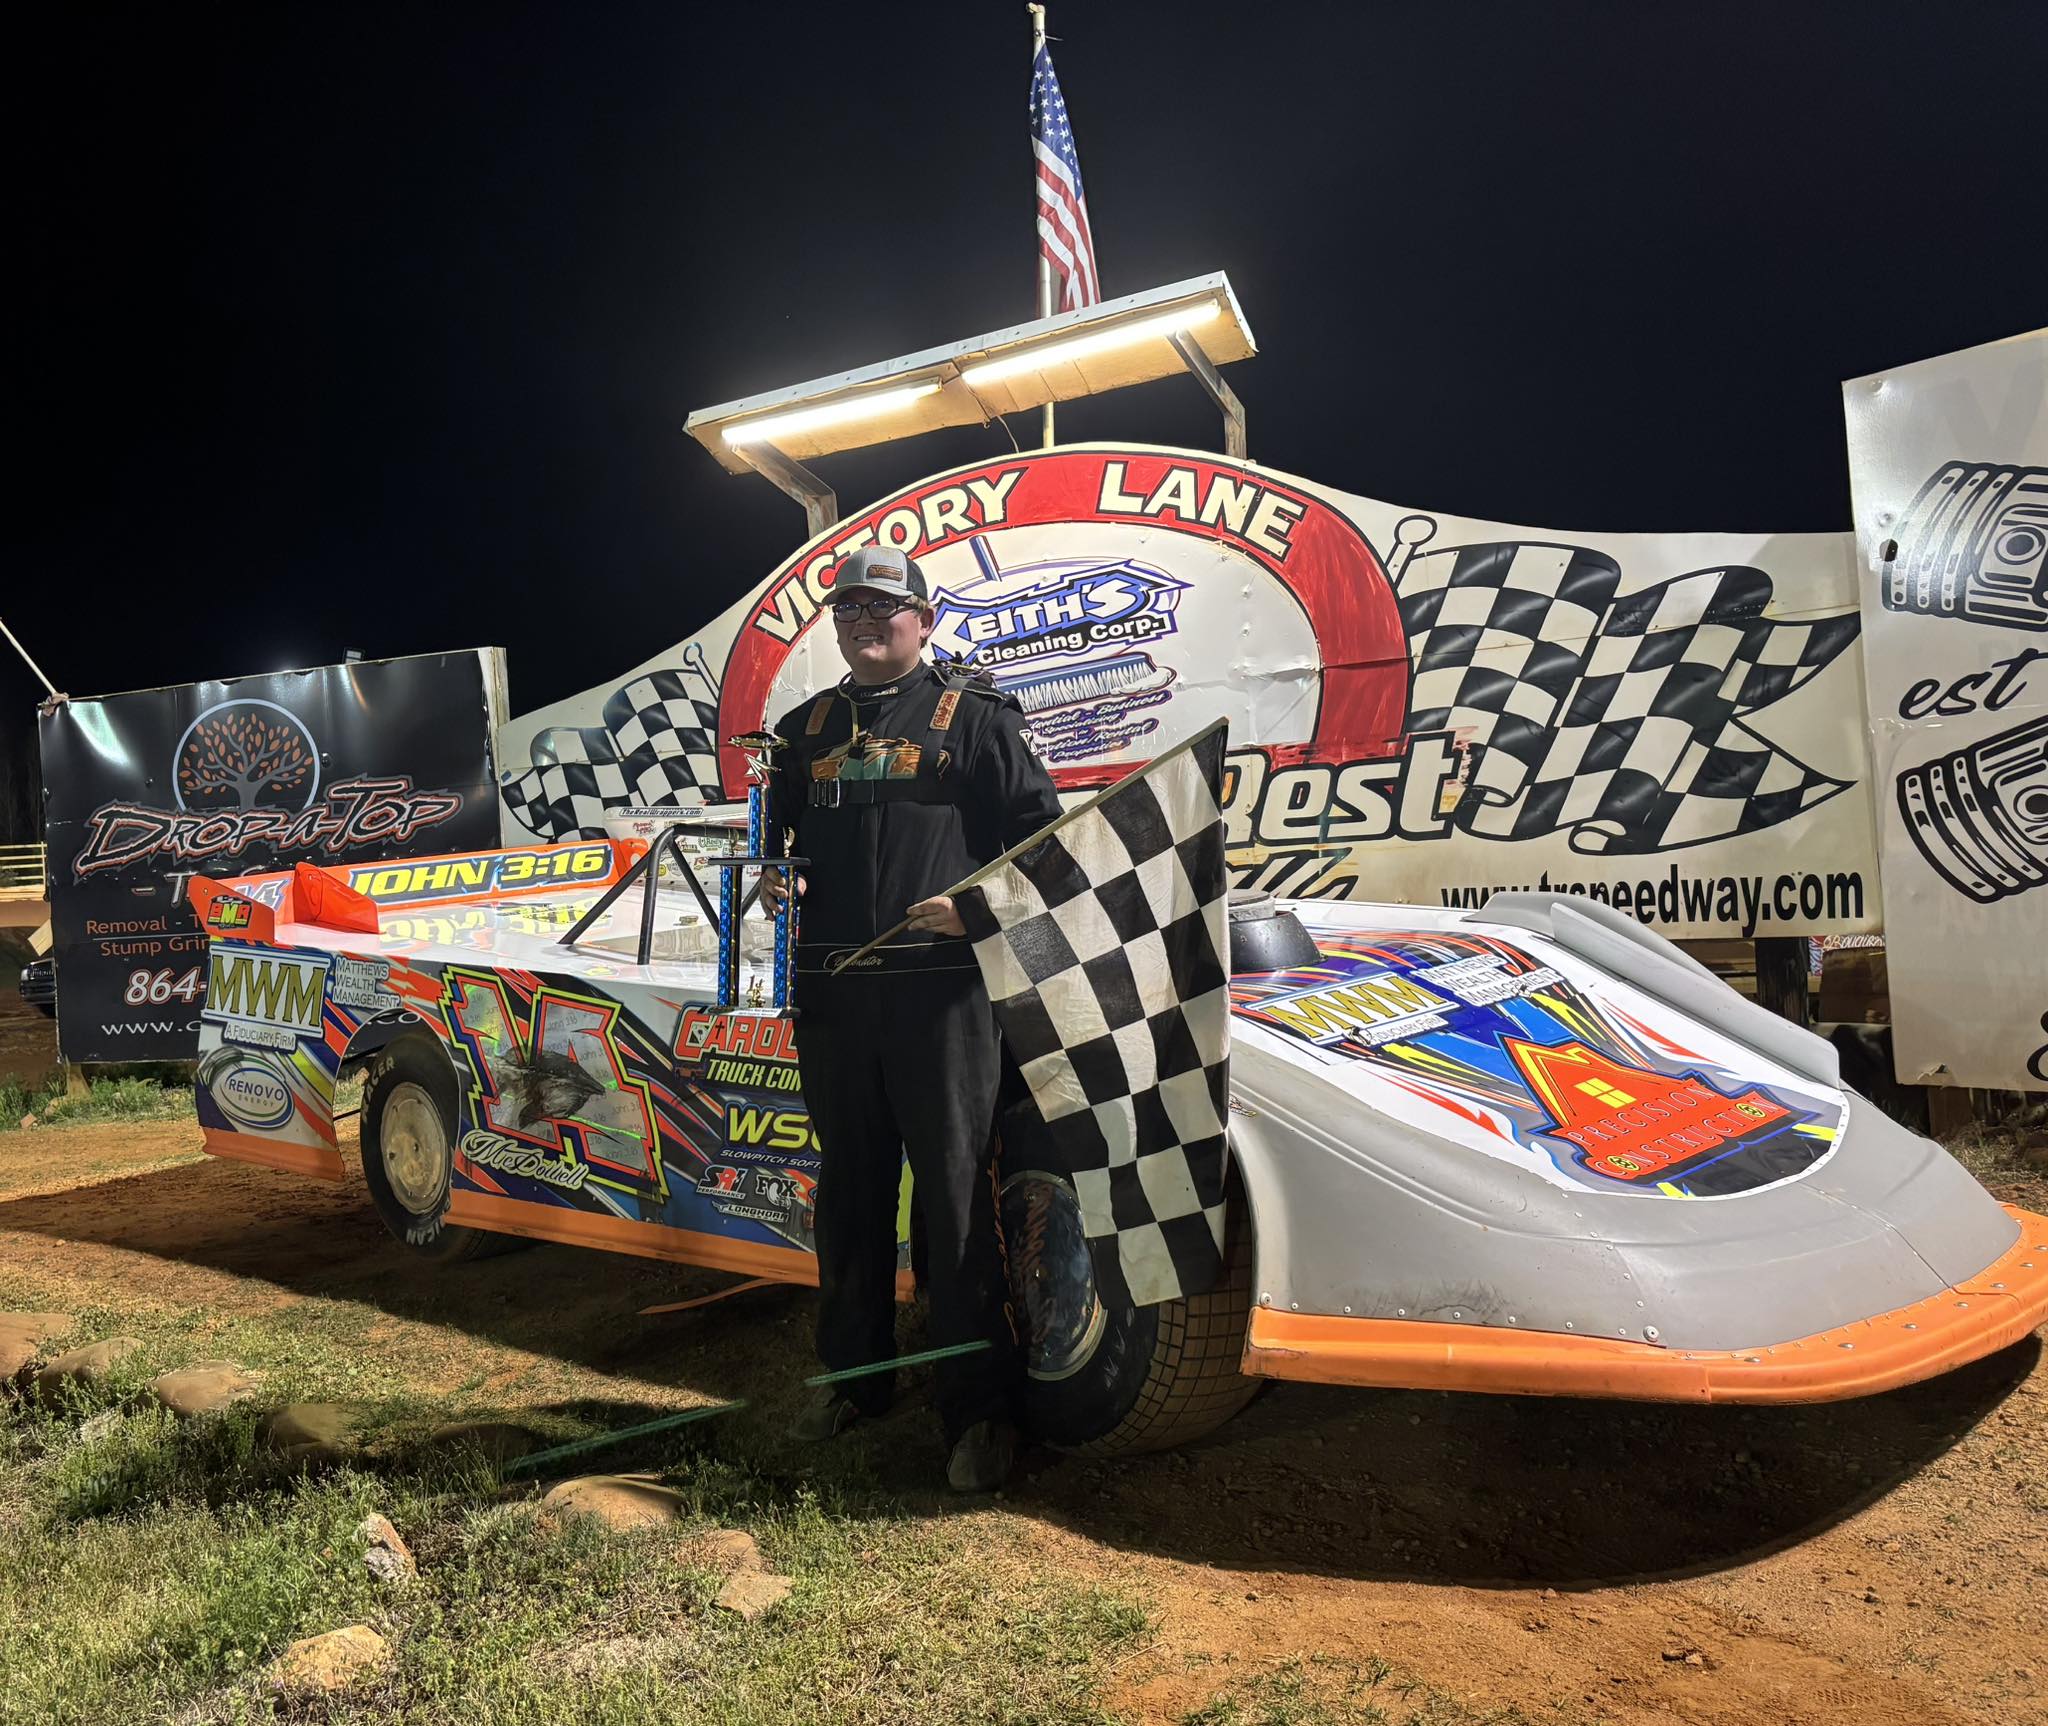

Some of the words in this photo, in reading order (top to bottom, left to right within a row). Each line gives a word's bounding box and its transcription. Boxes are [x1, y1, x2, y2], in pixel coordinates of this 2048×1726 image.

[1096, 460, 1308, 562] LANE
[977, 632, 1084, 666] Cleaning
[1089, 619, 1160, 642] Corp.
[1097, 692, 1166, 716] Business
[353, 860, 488, 897] JOHN
[500, 848, 605, 881] 3:16
[86, 915, 168, 935] Removal
[100, 941, 162, 960] Stump
[336, 959, 389, 978] MATTHEWS
[1424, 954, 1504, 980] MATTHEWS
[207, 955, 326, 1027] MWM
[336, 974, 375, 992] WEALTH
[1444, 968, 1508, 991] WEALTH
[333, 987, 399, 1008] MANAGEMENT
[1259, 975, 1448, 1038] MWM
[233, 1026, 274, 1044] FIDUCIARY
[274, 1032, 295, 1047] FIRM
[706, 1058, 766, 1086] TRUCK
[228, 1078, 284, 1101] RENOVO
[1567, 1085, 1718, 1147] PRECISION
[720, 1149, 787, 1164] SLOWPITCH
[788, 1157, 822, 1169] SOFT
[697, 1186, 746, 1200] PERFORMANCE
[756, 1174, 799, 1204] FOX
[727, 1204, 789, 1220] LONGHORN
